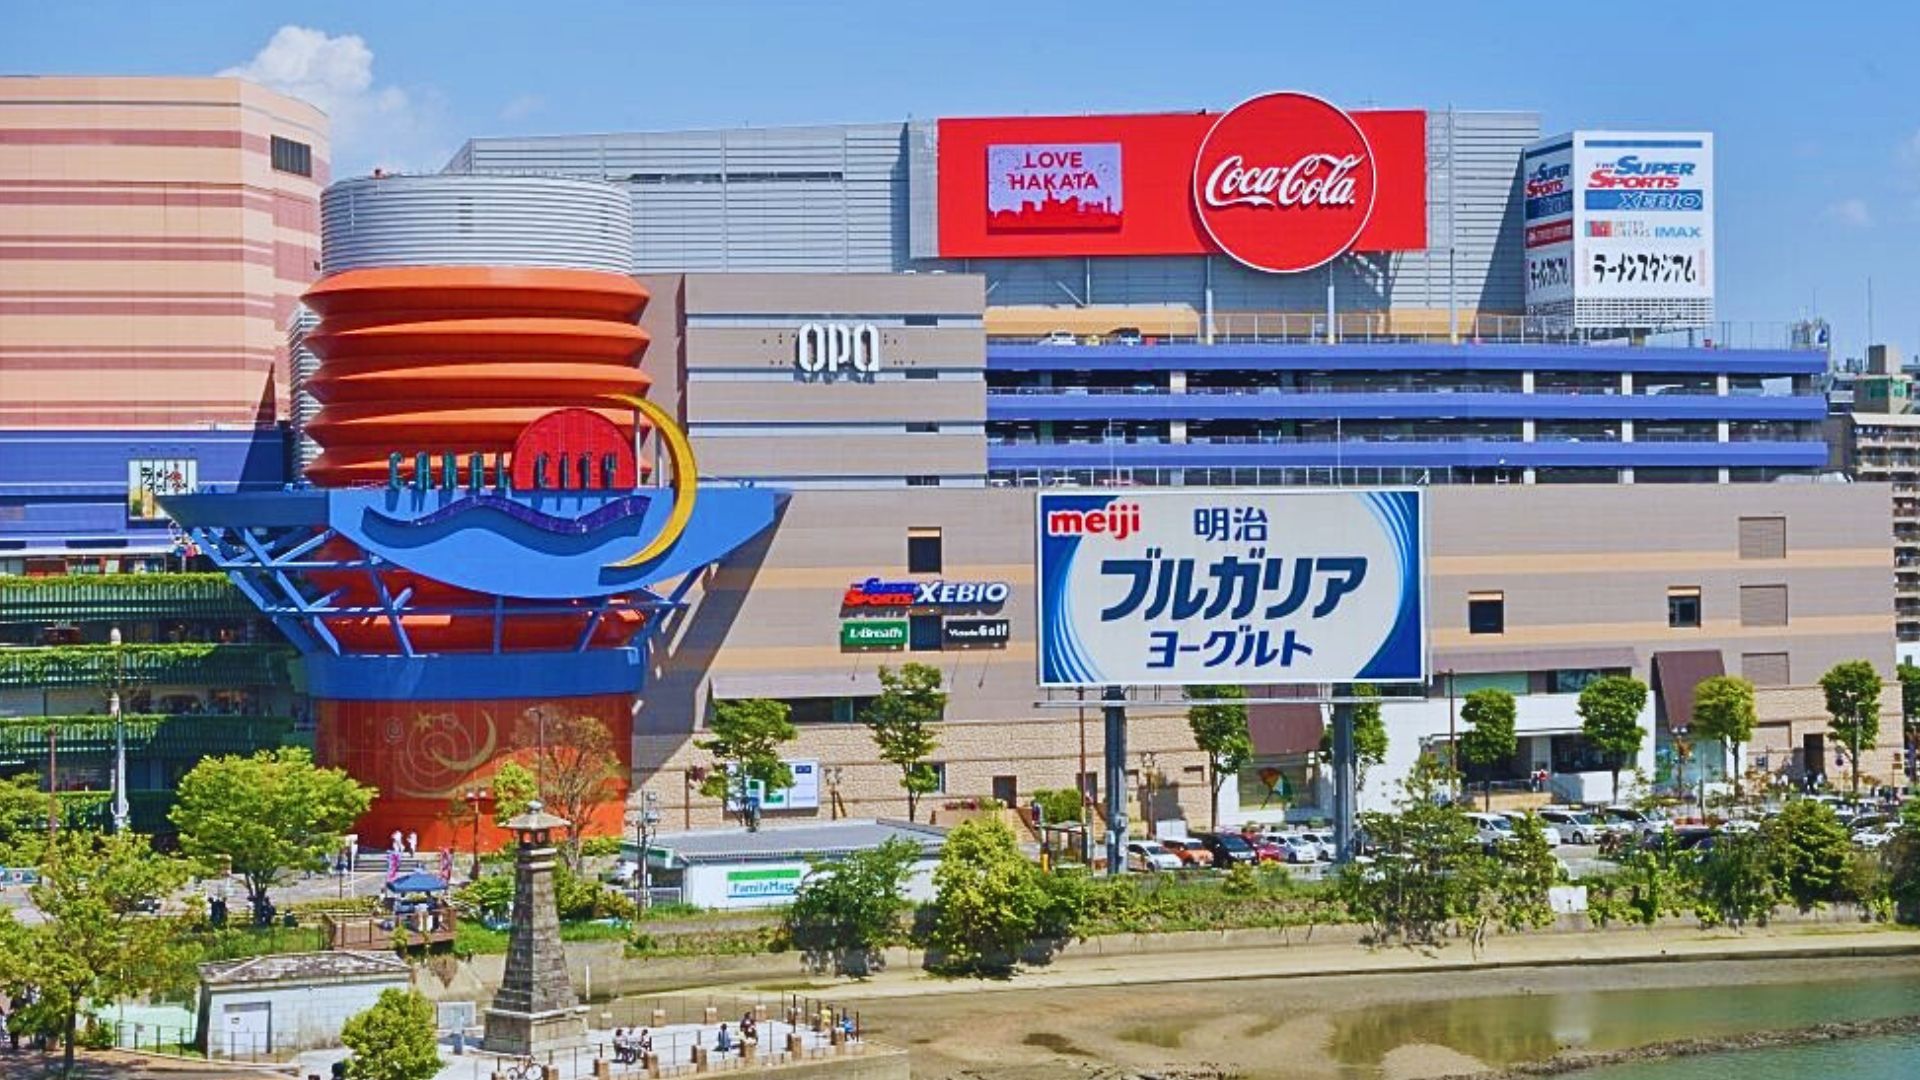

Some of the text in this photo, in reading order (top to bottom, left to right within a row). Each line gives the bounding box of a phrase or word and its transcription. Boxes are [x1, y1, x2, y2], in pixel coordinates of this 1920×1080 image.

[1023, 151, 1083, 169] LOVE
[1613, 155, 1696, 176] SUPER
[1006, 172, 1099, 190] HAKATA
[1205, 153, 1366, 207] Coca-Cola
[1587, 170, 1680, 189] SPORTS
[1655, 226, 1702, 238] IMAX
[1049, 504, 1141, 540] meiji
[1193, 507, 1268, 542] 明治
[917, 580, 1008, 603] XEBIO
[1101, 548, 1368, 621] ブルガリア
[978, 623, 1008, 637] Golf
[1146, 625, 1313, 668] ヨーグルト
